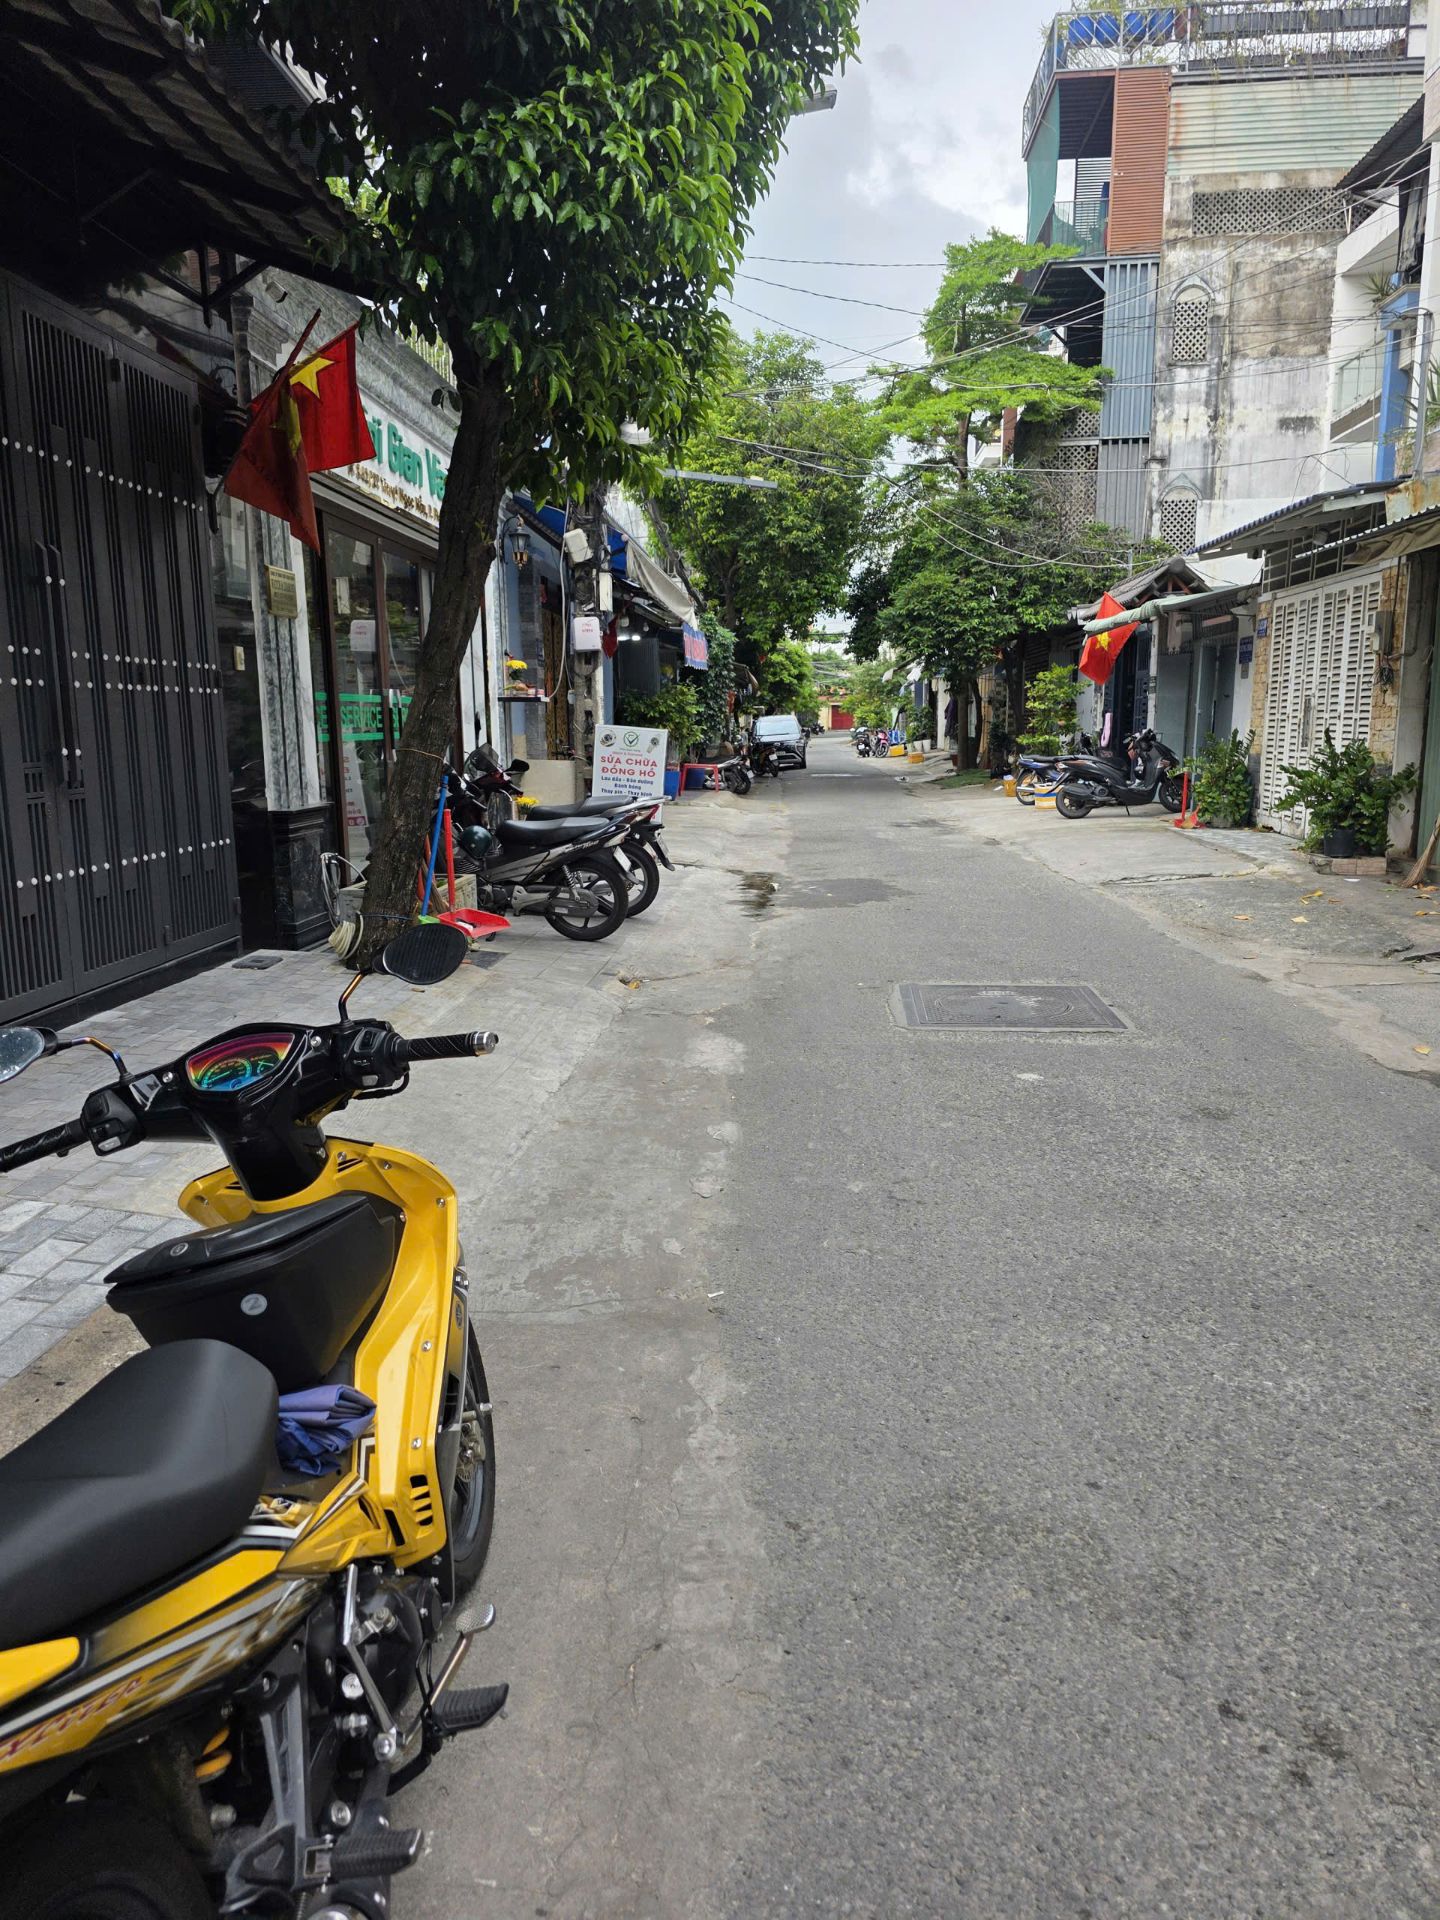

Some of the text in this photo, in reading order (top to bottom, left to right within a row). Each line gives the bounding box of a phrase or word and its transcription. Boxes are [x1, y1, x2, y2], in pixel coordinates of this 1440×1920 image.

[387, 421, 423, 489] Gian
[340, 705, 383, 728] SERVICE
[600, 754, 621, 764] SỬA
[626, 757, 658, 767] CHỮA
